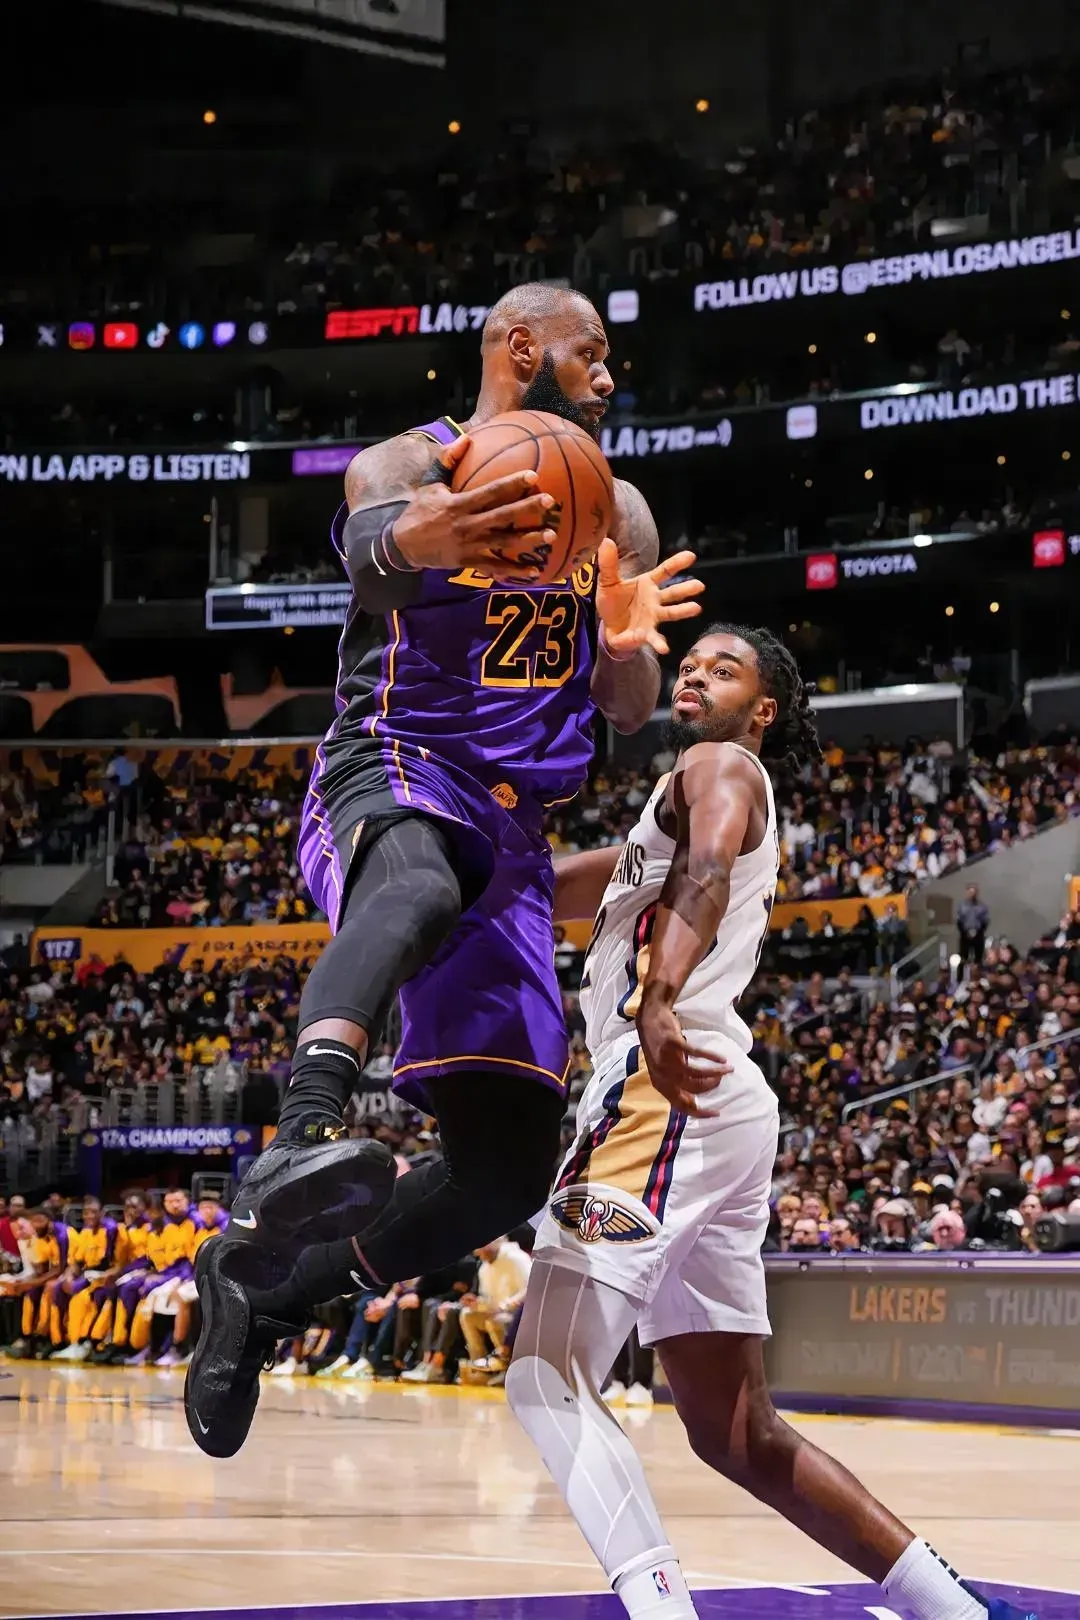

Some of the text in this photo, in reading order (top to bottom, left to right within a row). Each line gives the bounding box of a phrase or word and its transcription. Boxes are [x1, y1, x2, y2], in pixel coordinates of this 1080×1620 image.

[695, 229, 1080, 311] FOLLOW US @ESPNLOSANGEL
[860, 384, 1018, 429] DOWNLOAD
[1020, 374, 1075, 409] THE
[32, 455, 65, 480] LA
[68, 455, 125, 480] APP
[128, 455, 150, 480] &
[153, 452, 250, 480] LISTEN
[841, 553, 918, 578] TOYOTA
[480, 591, 578, 688] 23
[128, 1127, 232, 1148] CHAMPIONS
[850, 1286, 948, 1323] LAKERS
